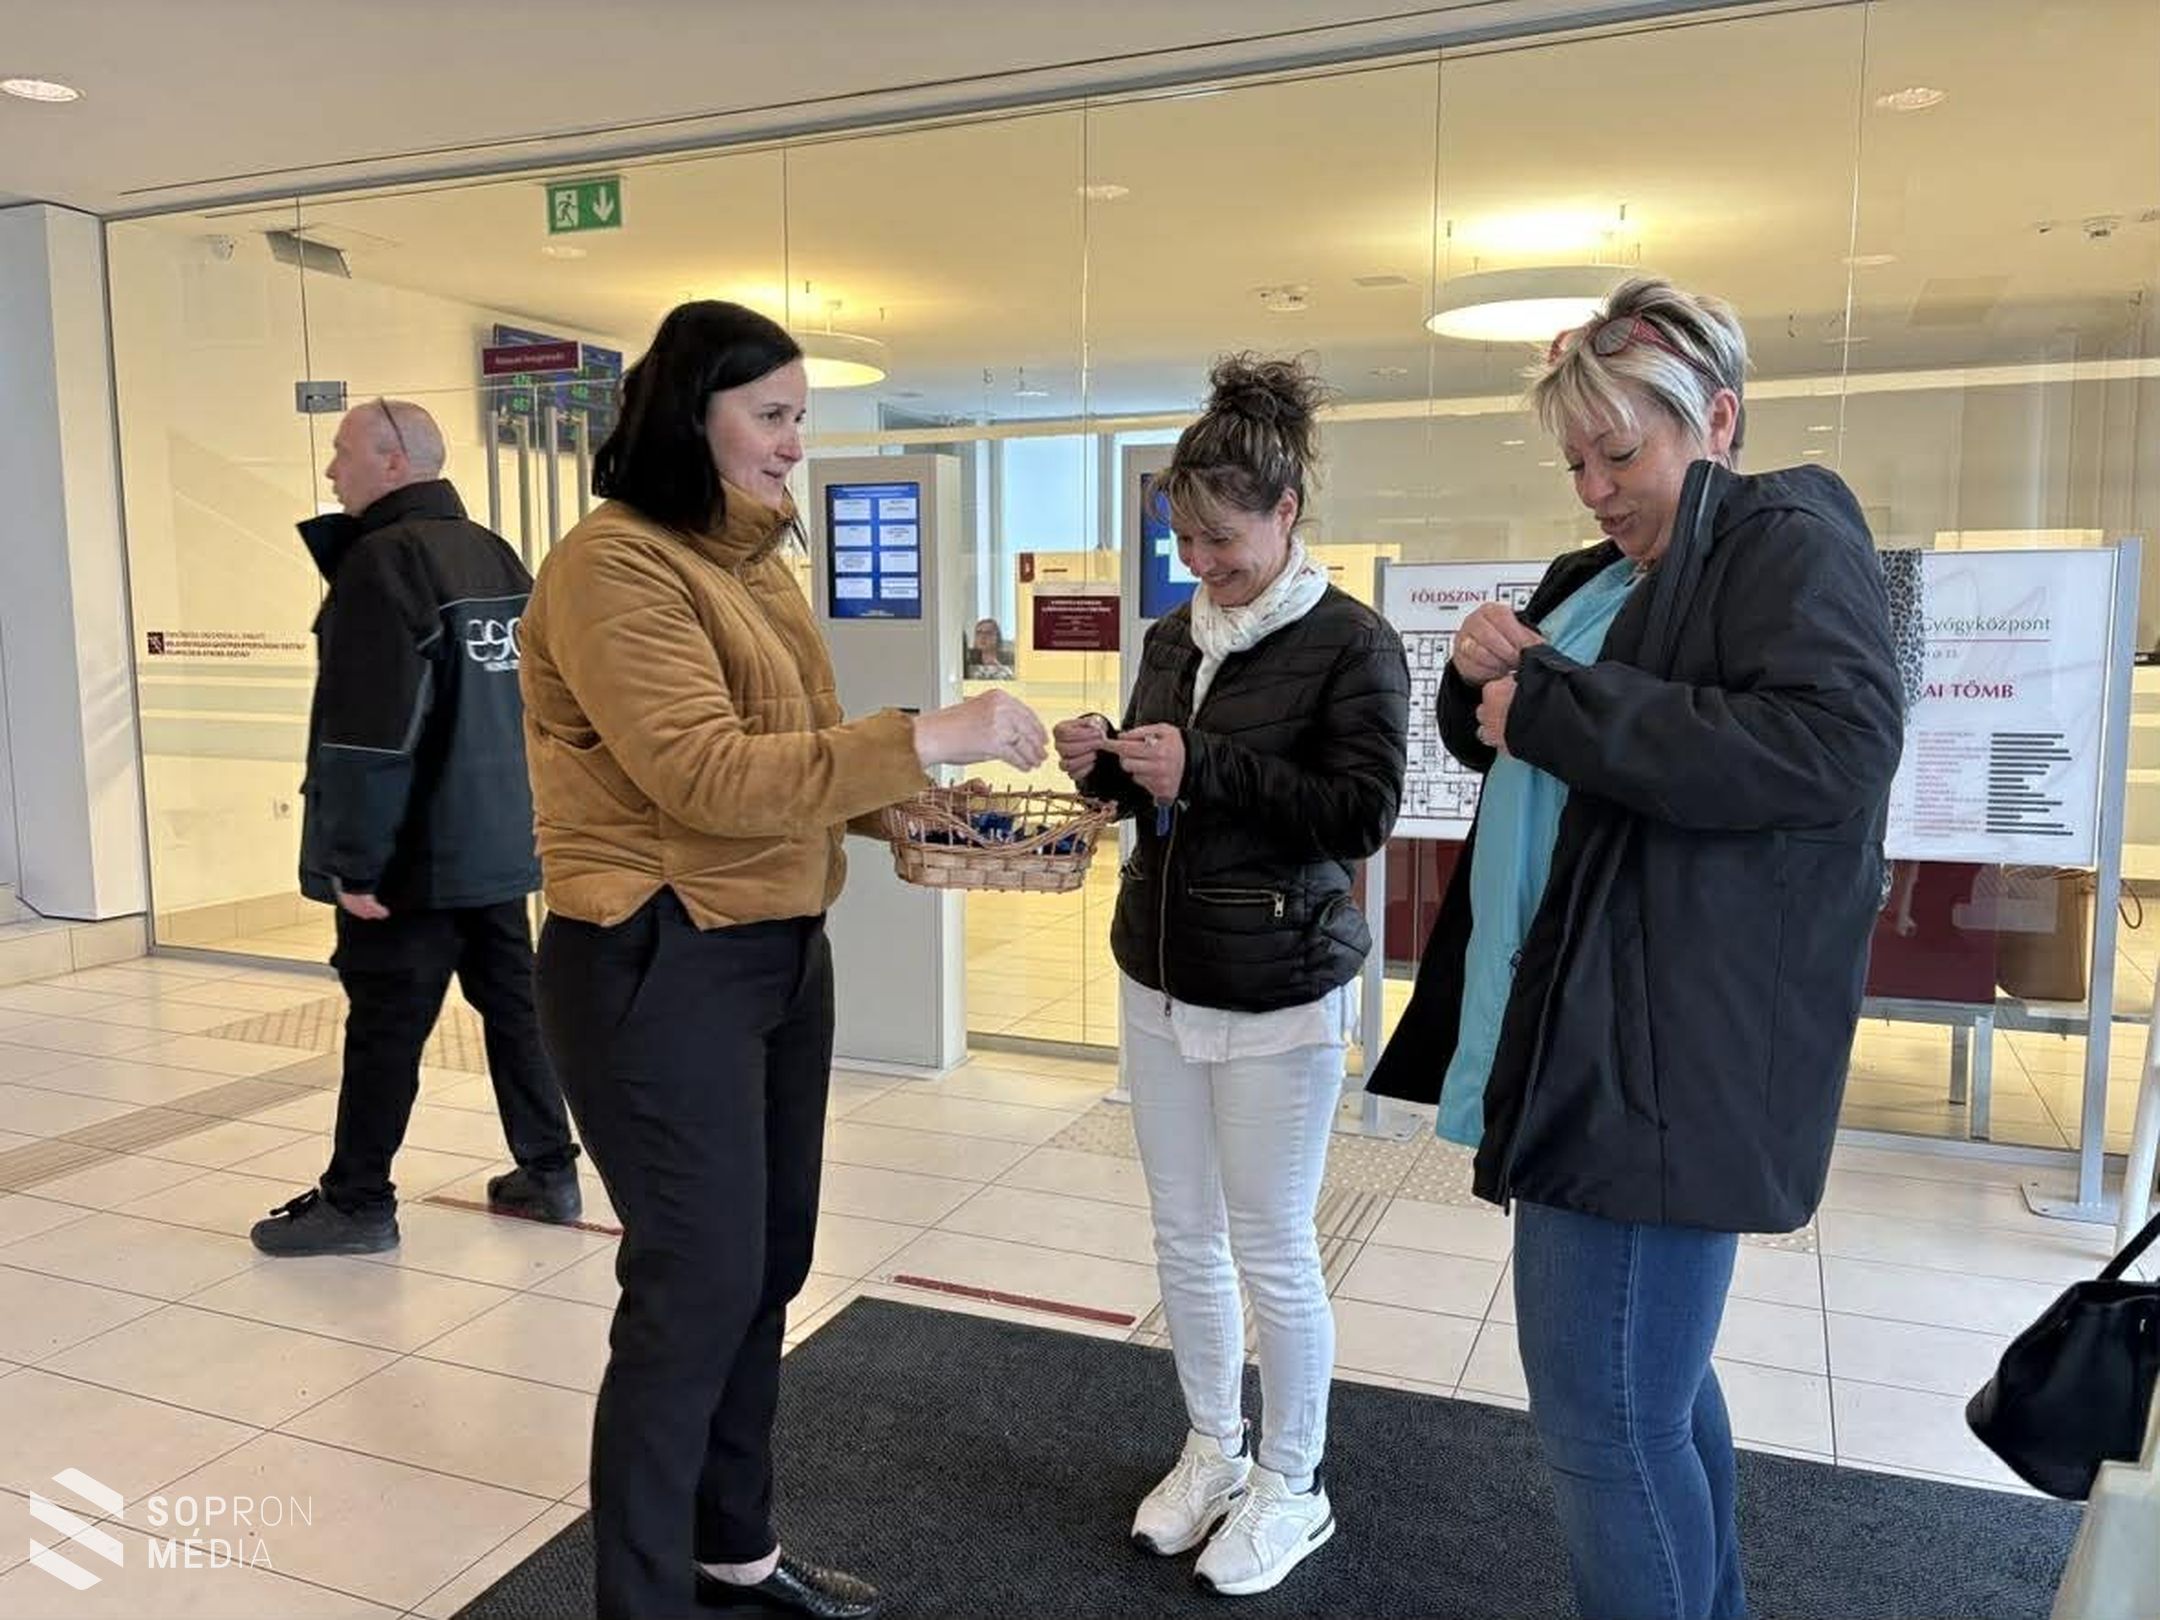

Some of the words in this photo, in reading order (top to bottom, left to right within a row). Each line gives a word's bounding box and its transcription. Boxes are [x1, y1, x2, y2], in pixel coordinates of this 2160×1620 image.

[1411, 588, 1488, 603] FÖLDSZINT
[1922, 683, 1943, 698] AI
[1950, 679, 2014, 699] TÖMB
